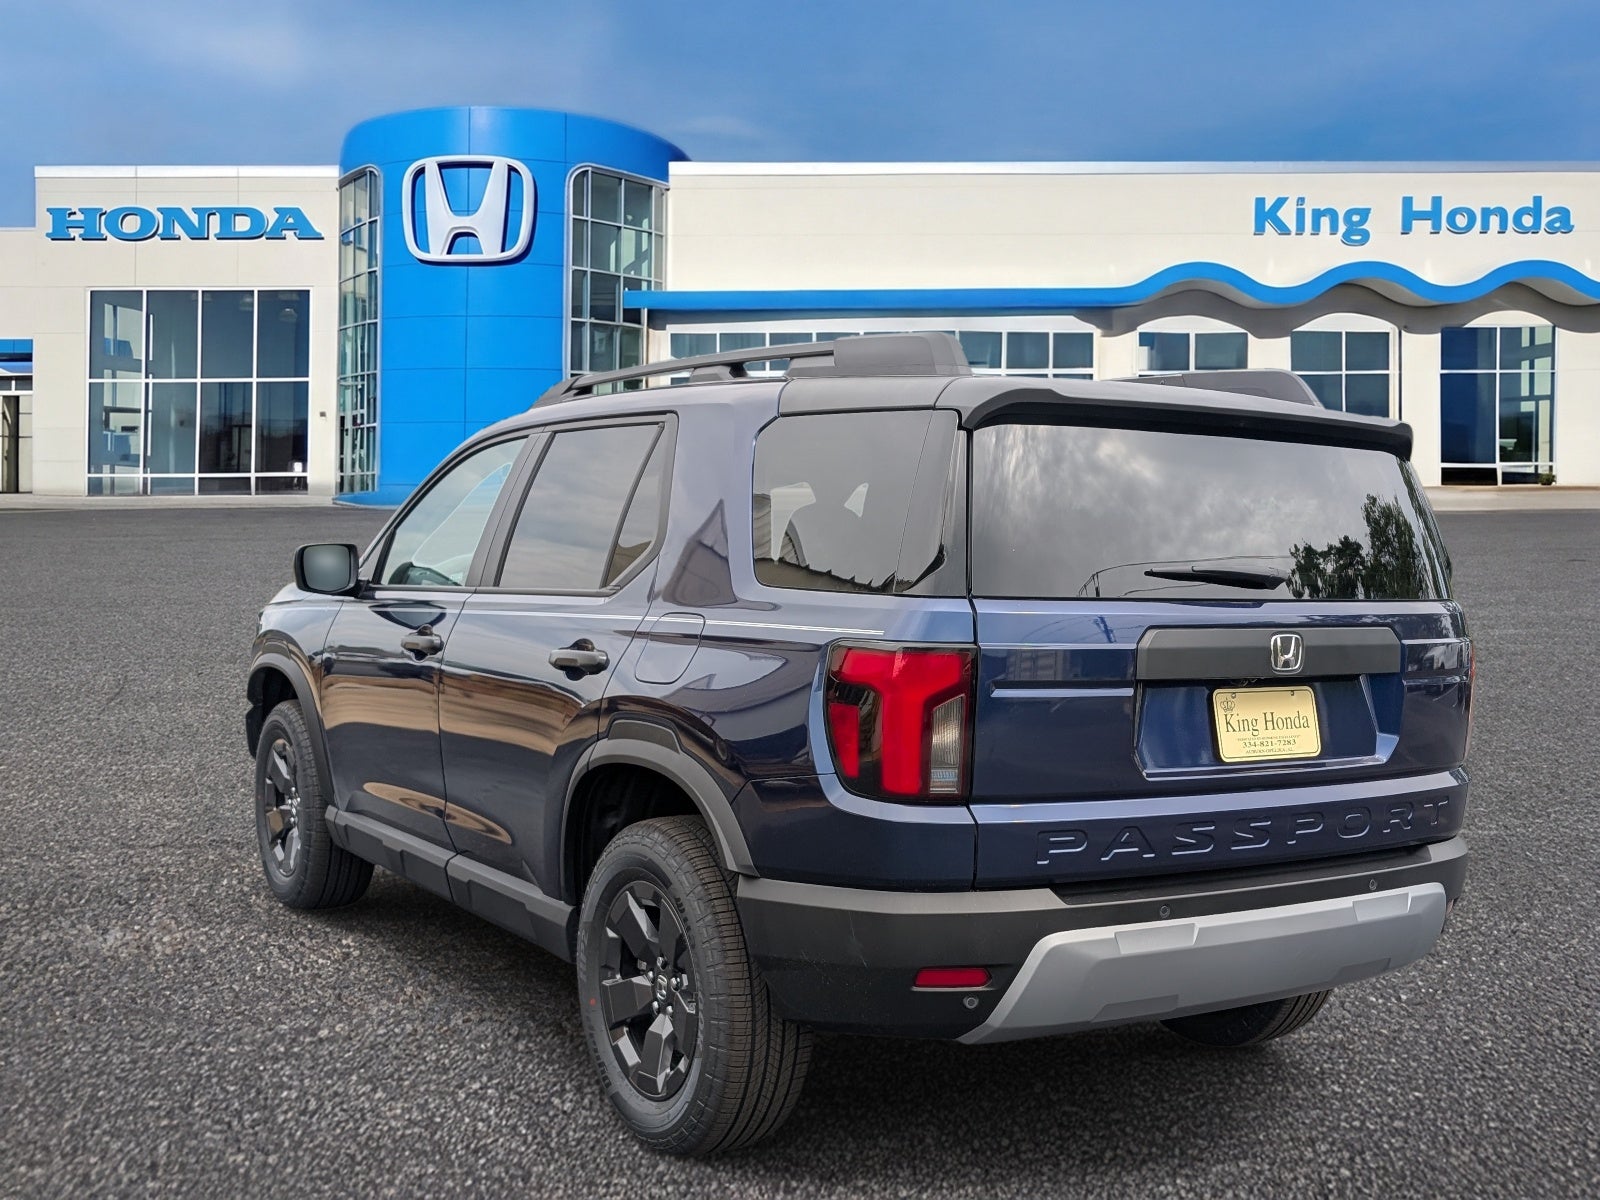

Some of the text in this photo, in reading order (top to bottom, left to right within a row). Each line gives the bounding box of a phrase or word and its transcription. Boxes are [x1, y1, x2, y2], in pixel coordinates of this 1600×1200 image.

[46, 206, 324, 241] HONDA
[1254, 195, 1575, 246] King Honda
[1224, 711, 1310, 737] King Honda
[1242, 739, 1297, 748] 334-821-7283
[1036, 799, 1449, 864] PASSPORT
